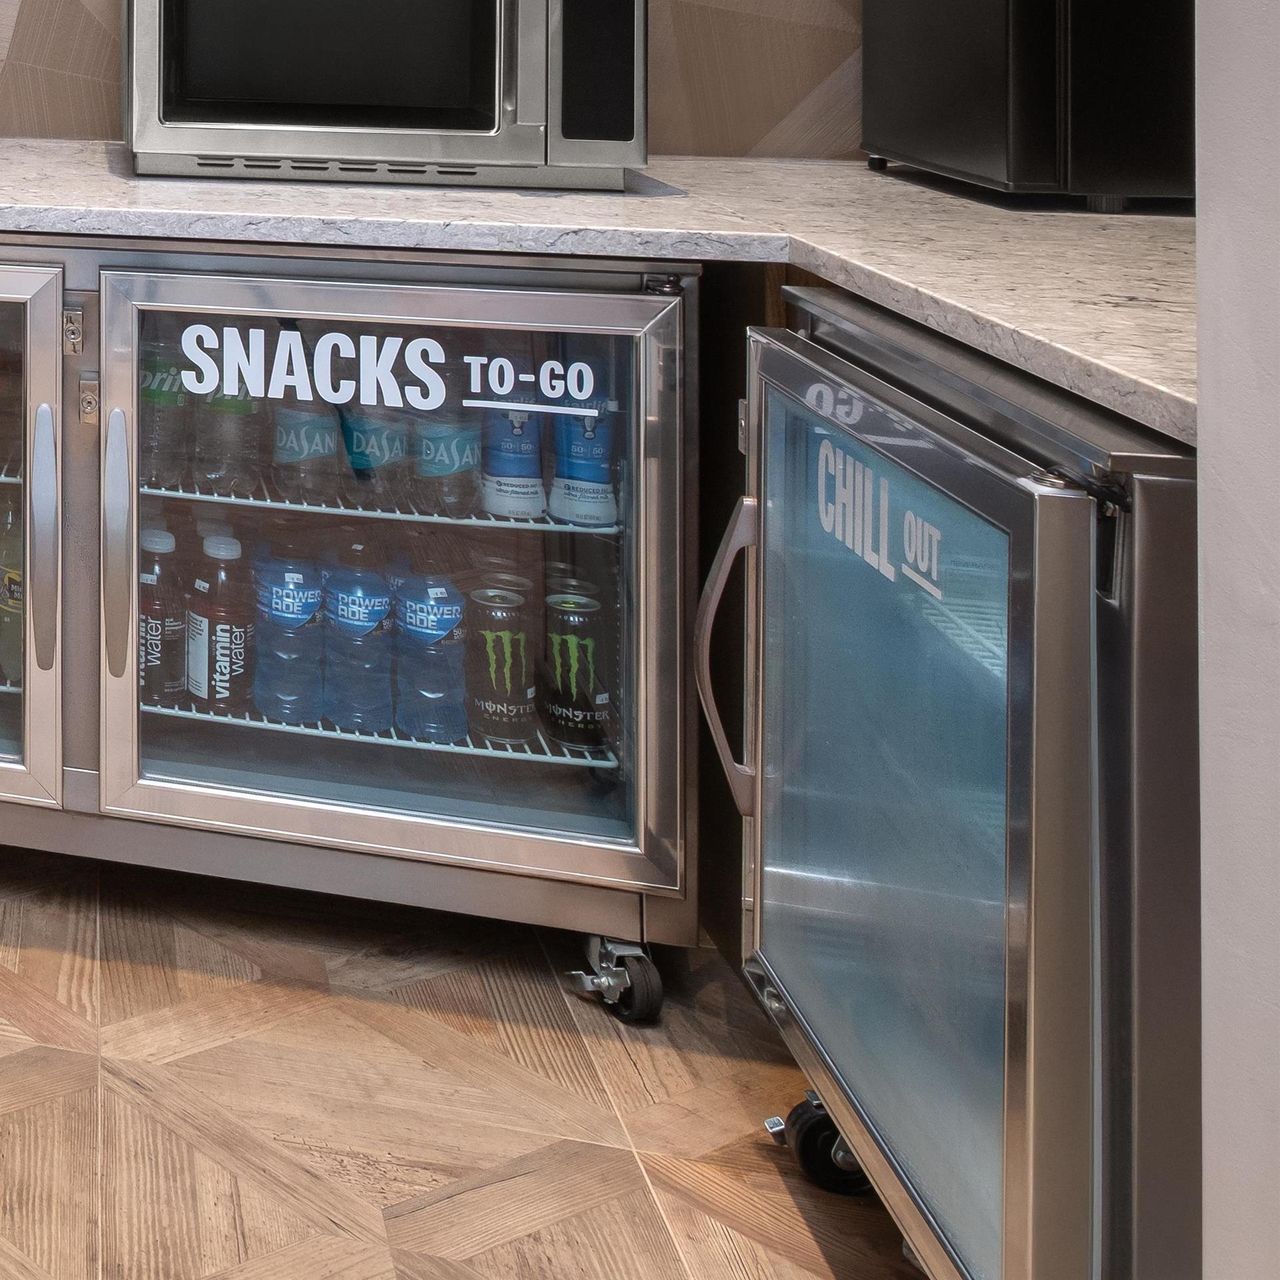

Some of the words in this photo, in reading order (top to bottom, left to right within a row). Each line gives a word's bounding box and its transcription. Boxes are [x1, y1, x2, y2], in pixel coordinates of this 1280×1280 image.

[180, 324, 447, 411] SNACKS
[464, 355, 594, 400] TO-GO
[817, 438, 895, 582] CHILL
[903, 510, 941, 581] OUT
[272, 587, 320, 603] POWER
[339, 594, 389, 609] POWER
[272, 600, 302, 613] ADE
[339, 606, 369, 621] ADE
[406, 601, 460, 618] POWER
[406, 615, 438, 629] ADE
[147, 616, 161, 665] water
[232, 625, 244, 675] water
[212, 624, 230, 698] vitamin
